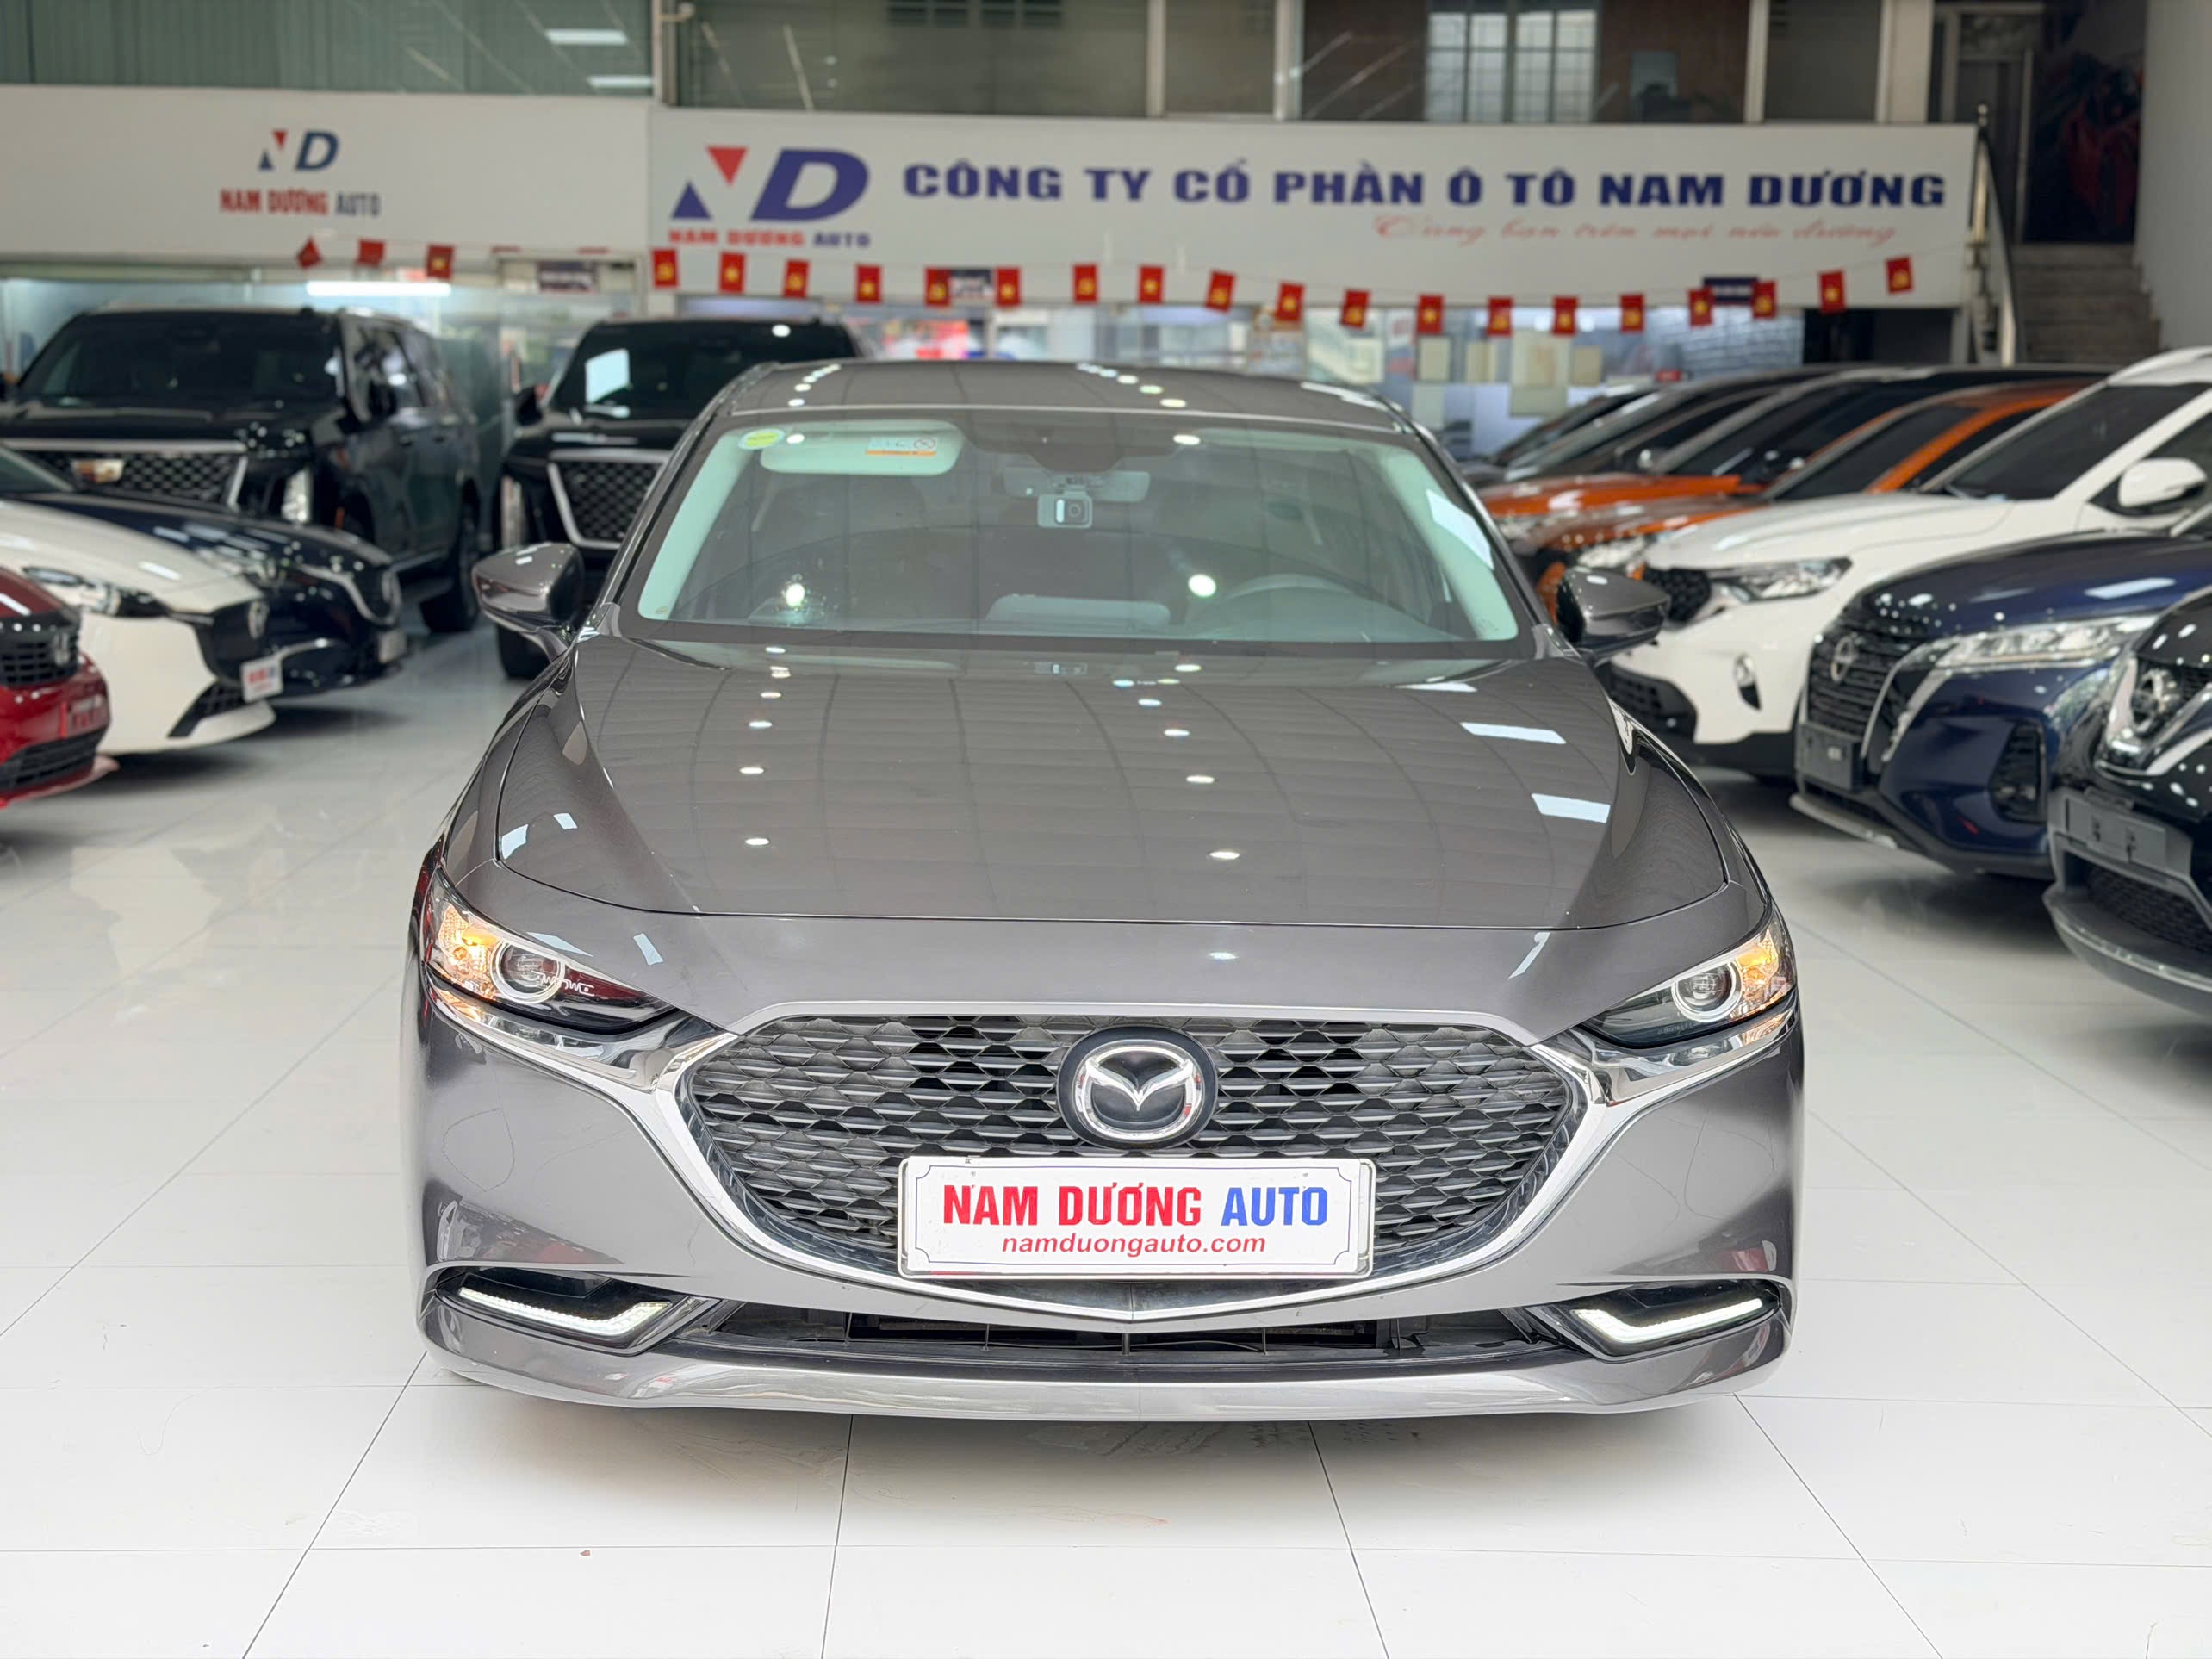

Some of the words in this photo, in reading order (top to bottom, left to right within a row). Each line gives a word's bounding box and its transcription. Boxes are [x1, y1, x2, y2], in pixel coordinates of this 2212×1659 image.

[904, 158, 1062, 200] CÔNG
[1084, 168, 1152, 202] TY
[1447, 165, 1482, 206] Ô
[1504, 166, 1576, 206] TÔ
[1599, 174, 1724, 207] NAM
[1748, 170, 1946, 208] DƯƠNG
[221, 189, 262, 213] NAM
[336, 190, 381, 217] AUTO
[668, 229, 718, 245] NAM
[813, 231, 871, 247] AUTO
[943, 1184, 1039, 1225] NAM
[1058, 1181, 1201, 1227] DƯƠNG
[1221, 1186, 1328, 1226] AUTO
[1002, 1233, 1265, 1258] namduongauto.com
